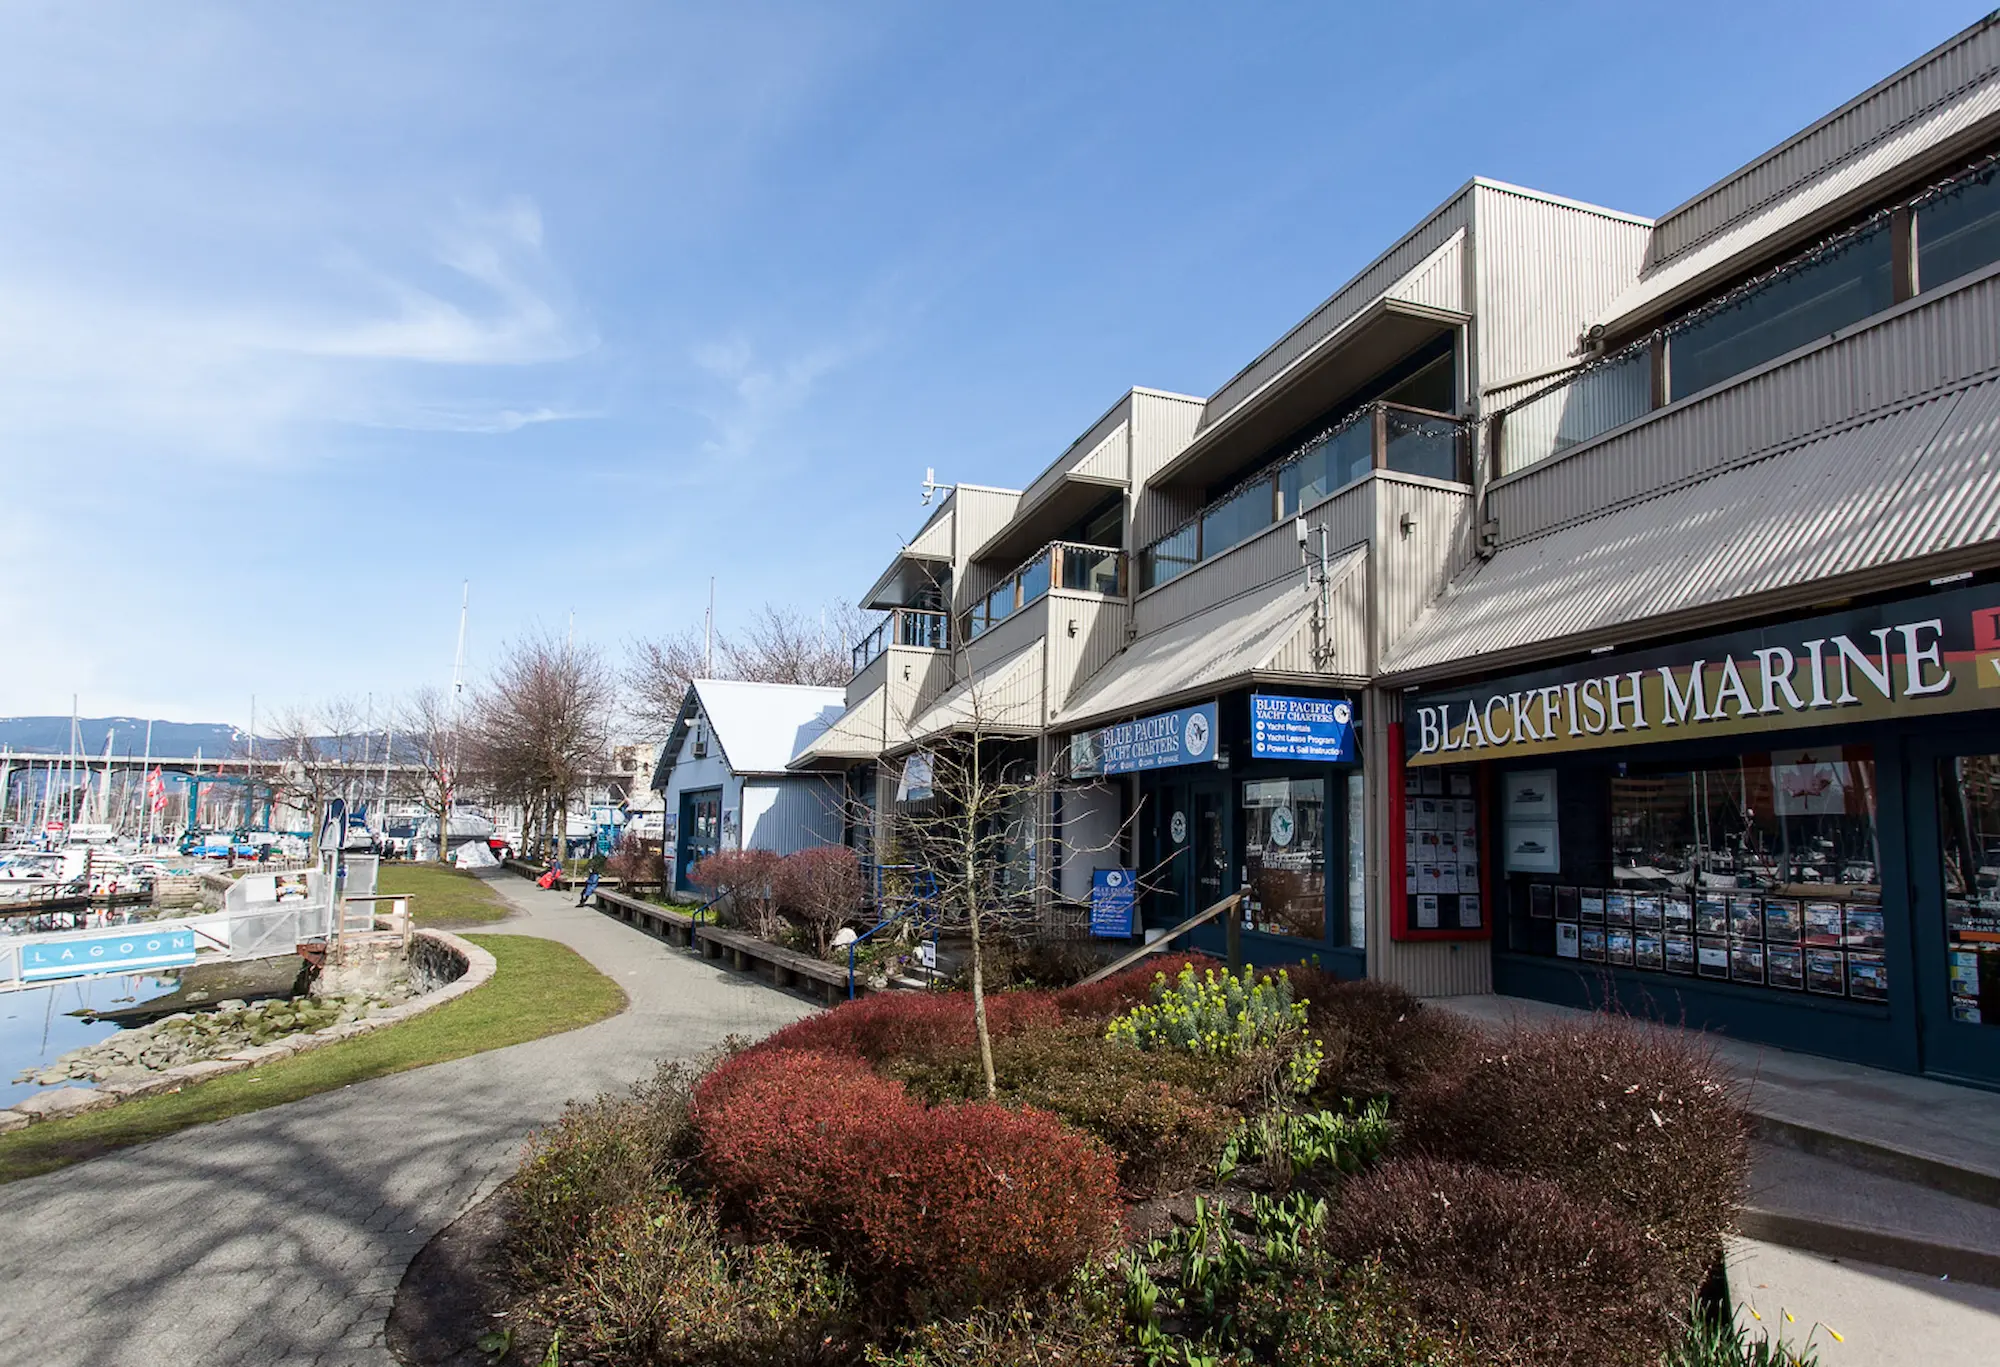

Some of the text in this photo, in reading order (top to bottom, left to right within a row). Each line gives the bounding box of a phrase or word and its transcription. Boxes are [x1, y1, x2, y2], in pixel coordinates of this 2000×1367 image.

[1417, 618, 1951, 753] BLACKFISH MARINE
[1256, 699, 1333, 715] BLUE PACIFIC
[1256, 710, 1334, 723] YACHT CHARTERS
[1103, 724, 1133, 748] BLUE
[1134, 714, 1179, 742] PACIFIC
[1266, 723, 1311, 733] Yacht Rentals
[1266, 734, 1285, 742] Yacht
[1307, 735, 1336, 745] Program
[1103, 735, 1179, 762] YACHT CHARTERS
[1266, 744, 1288, 753] Power
[1289, 745, 1295, 753] &
[1310, 746, 1344, 755] Instruction
[34, 938, 185, 962] LAGOON
